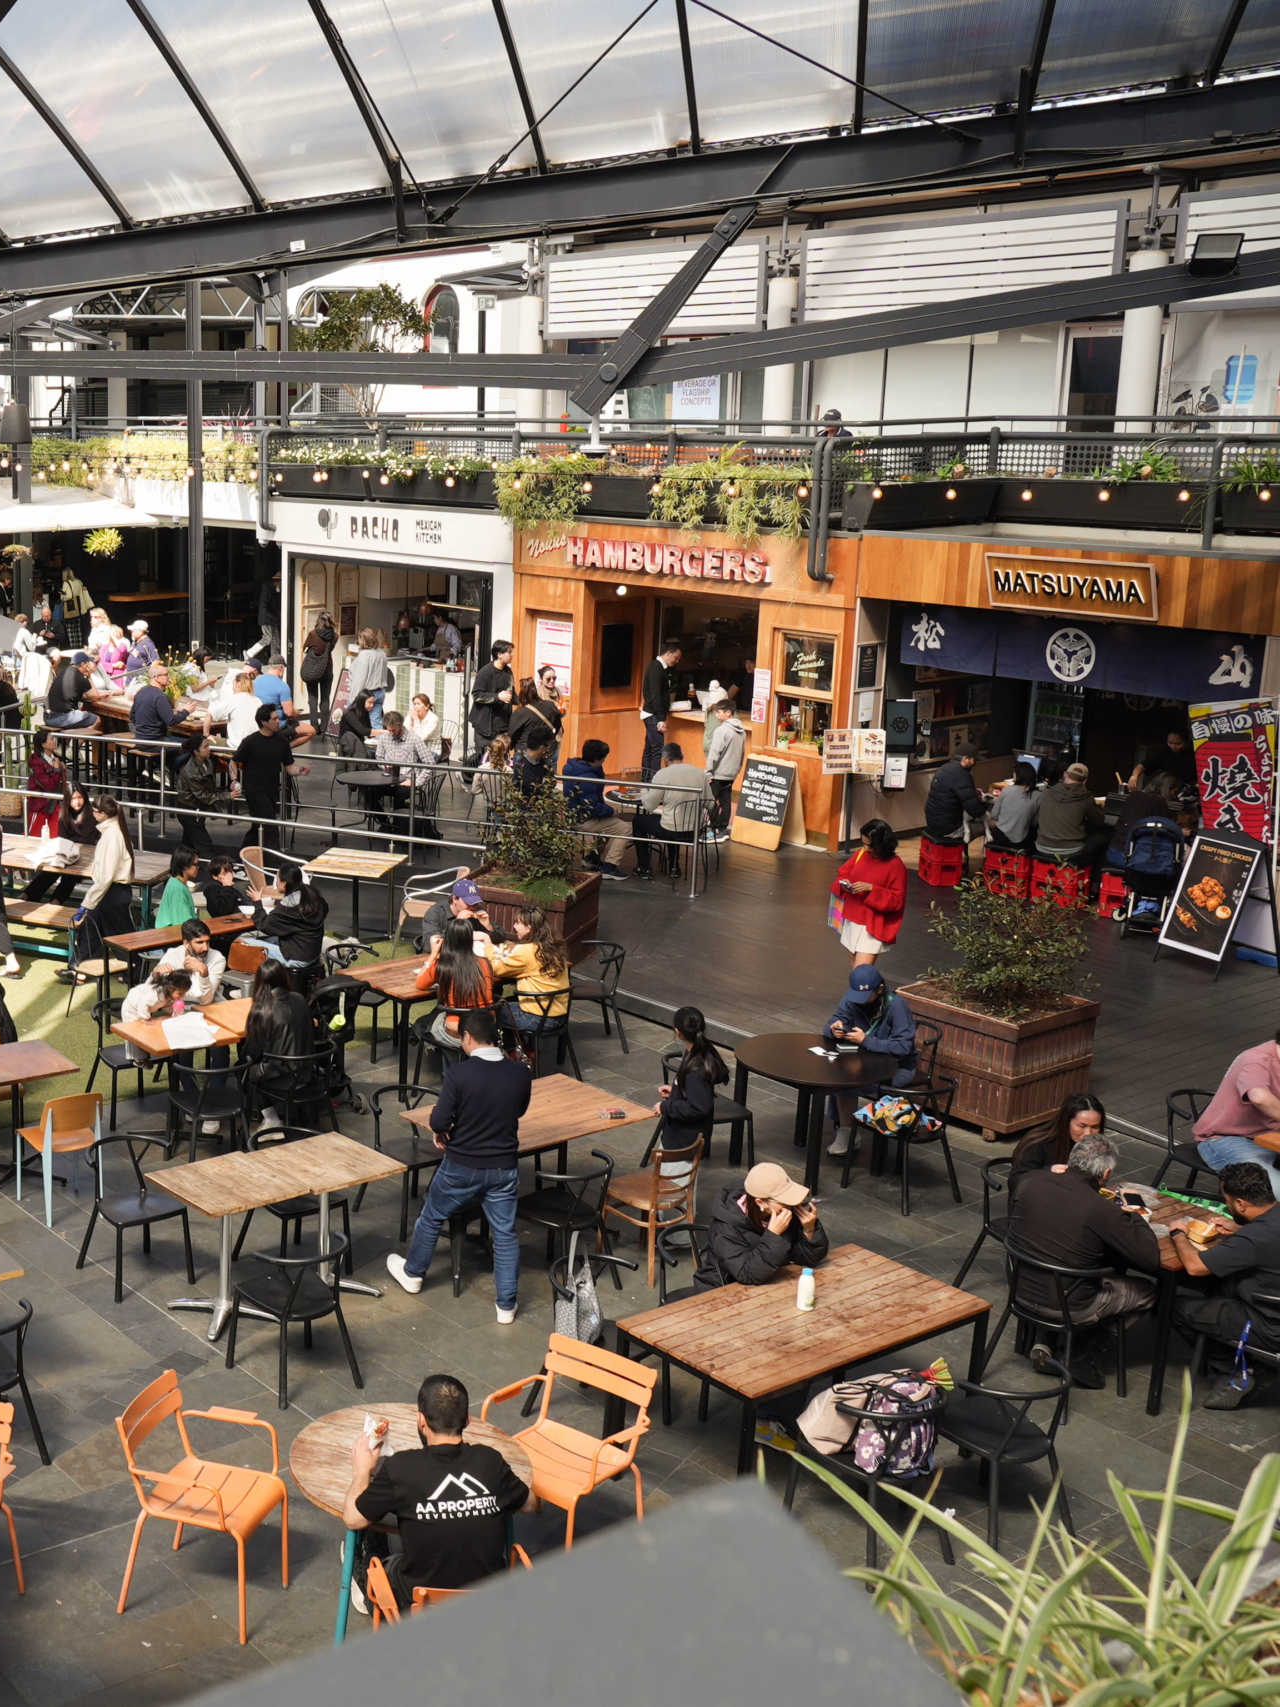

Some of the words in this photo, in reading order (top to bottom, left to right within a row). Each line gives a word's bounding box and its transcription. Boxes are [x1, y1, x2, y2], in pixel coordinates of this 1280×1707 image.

[677, 379, 706, 388] BEVERAGE
[707, 379, 716, 387] OR
[682, 388, 710, 397] FLAGSHIP
[680, 397, 711, 406] CONCEPTS
[350, 516, 399, 543] PACHO
[415, 519, 442, 531] MEXICAN
[415, 532, 442, 545] KITCHEN
[567, 536, 768, 583] HAMBURGERS
[993, 568, 1145, 604] MATSUYAMA
[910, 612, 945, 651] 松
[790, 658, 825, 671] Lemonade
[796, 651, 816, 664] Fresh
[1208, 644, 1254, 688] 山
[1200, 844, 1218, 853] CRISPY
[1217, 848, 1231, 858] FRIED
[1231, 851, 1254, 863] CHICKEN
[415, 1502, 436, 1514] AA
[437, 1495, 497, 1513] PROPERTY
[417, 1506, 501, 1520] DEVELOPMENTS
